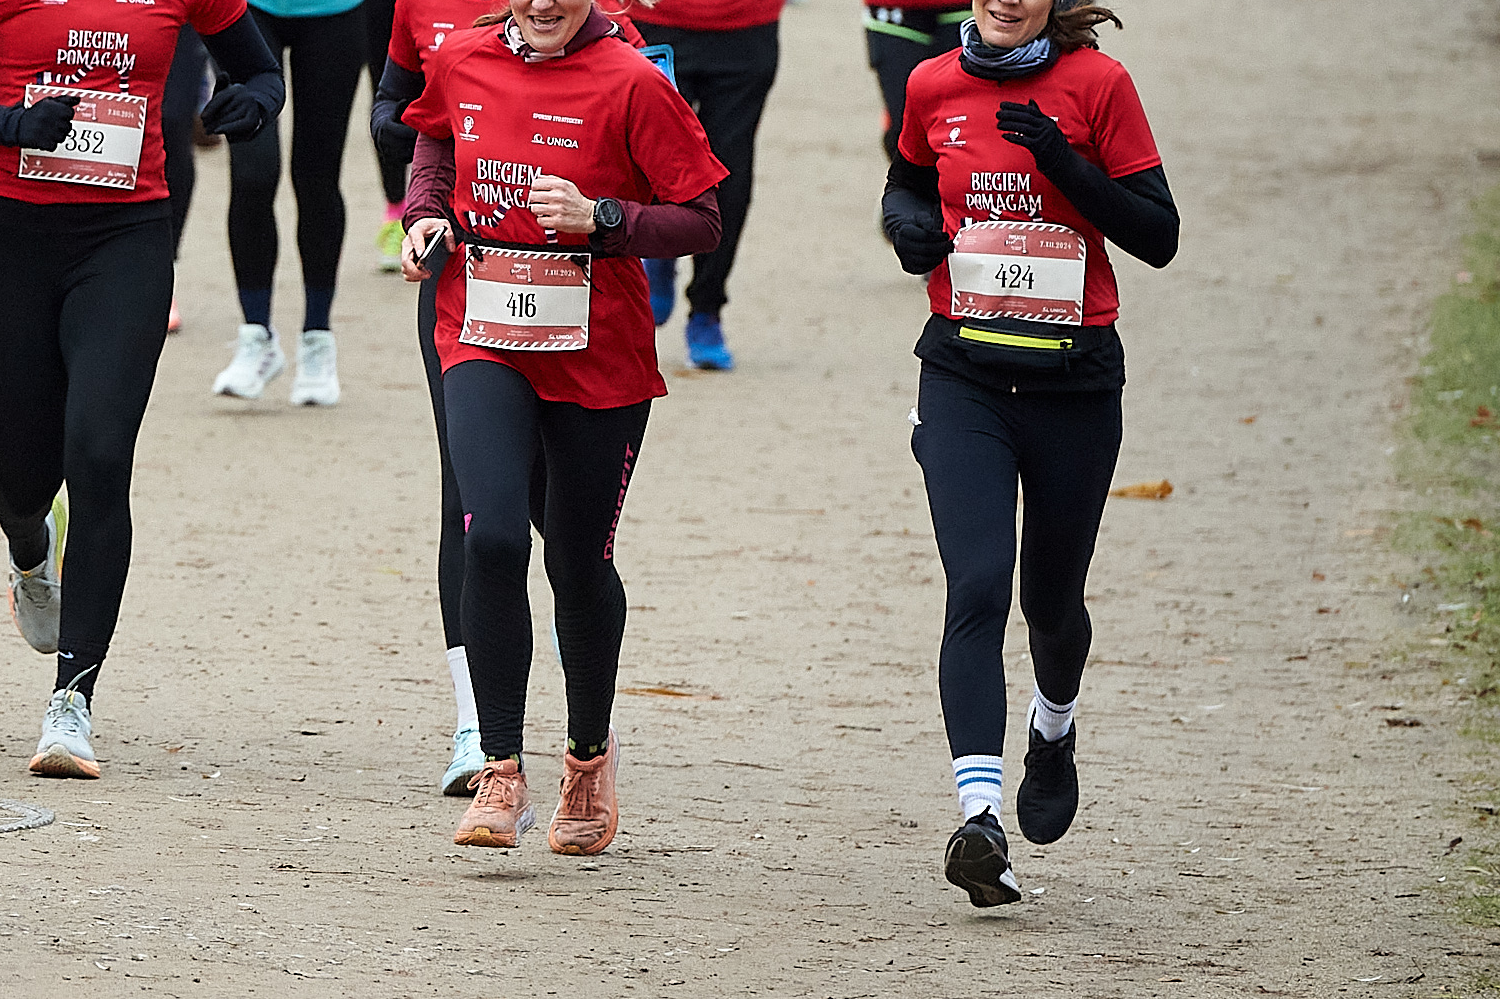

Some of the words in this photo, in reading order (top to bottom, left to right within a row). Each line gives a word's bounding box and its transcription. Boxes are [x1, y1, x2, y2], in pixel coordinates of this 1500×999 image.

[68, 30, 129, 51] BIEGIEM
[57, 49, 136, 70] POMAGAM
[65, 129, 105, 154] 352
[547, 136, 579, 149] UNIQA
[971, 172, 1030, 192] BIEGIEM
[471, 182, 533, 209] POMAG
[965, 193, 1042, 211] POMAGAM
[995, 263, 1035, 289] 424
[506, 292, 537, 318] 416
